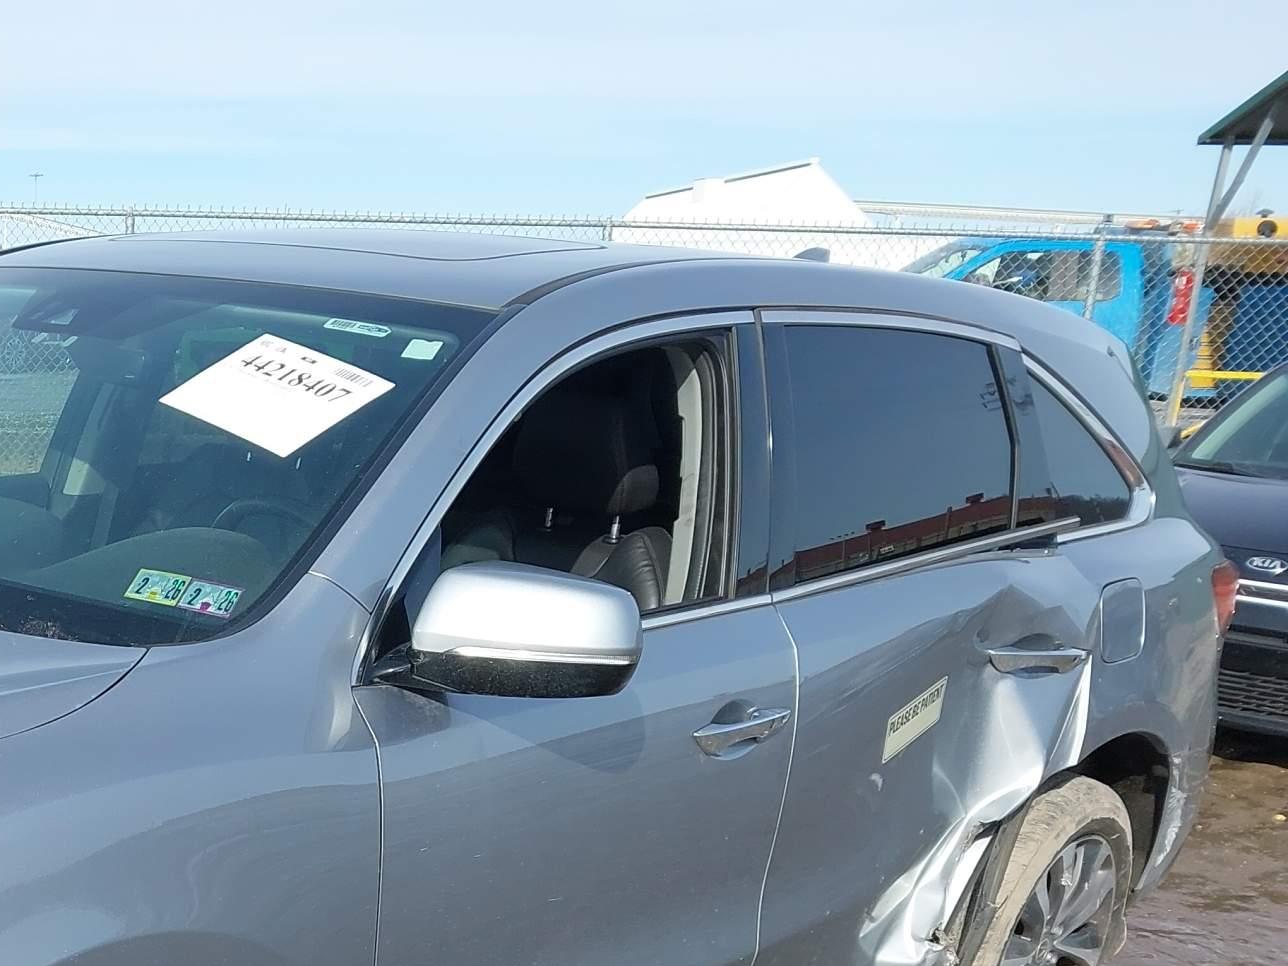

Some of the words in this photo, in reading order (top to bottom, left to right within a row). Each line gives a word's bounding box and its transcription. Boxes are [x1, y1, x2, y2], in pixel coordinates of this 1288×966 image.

[241, 355, 353, 402] 44218407
[135, 577, 150, 594] 2
[164, 579, 186, 600] 26
[187, 588, 202, 606] 2
[217, 590, 239, 612] 26
